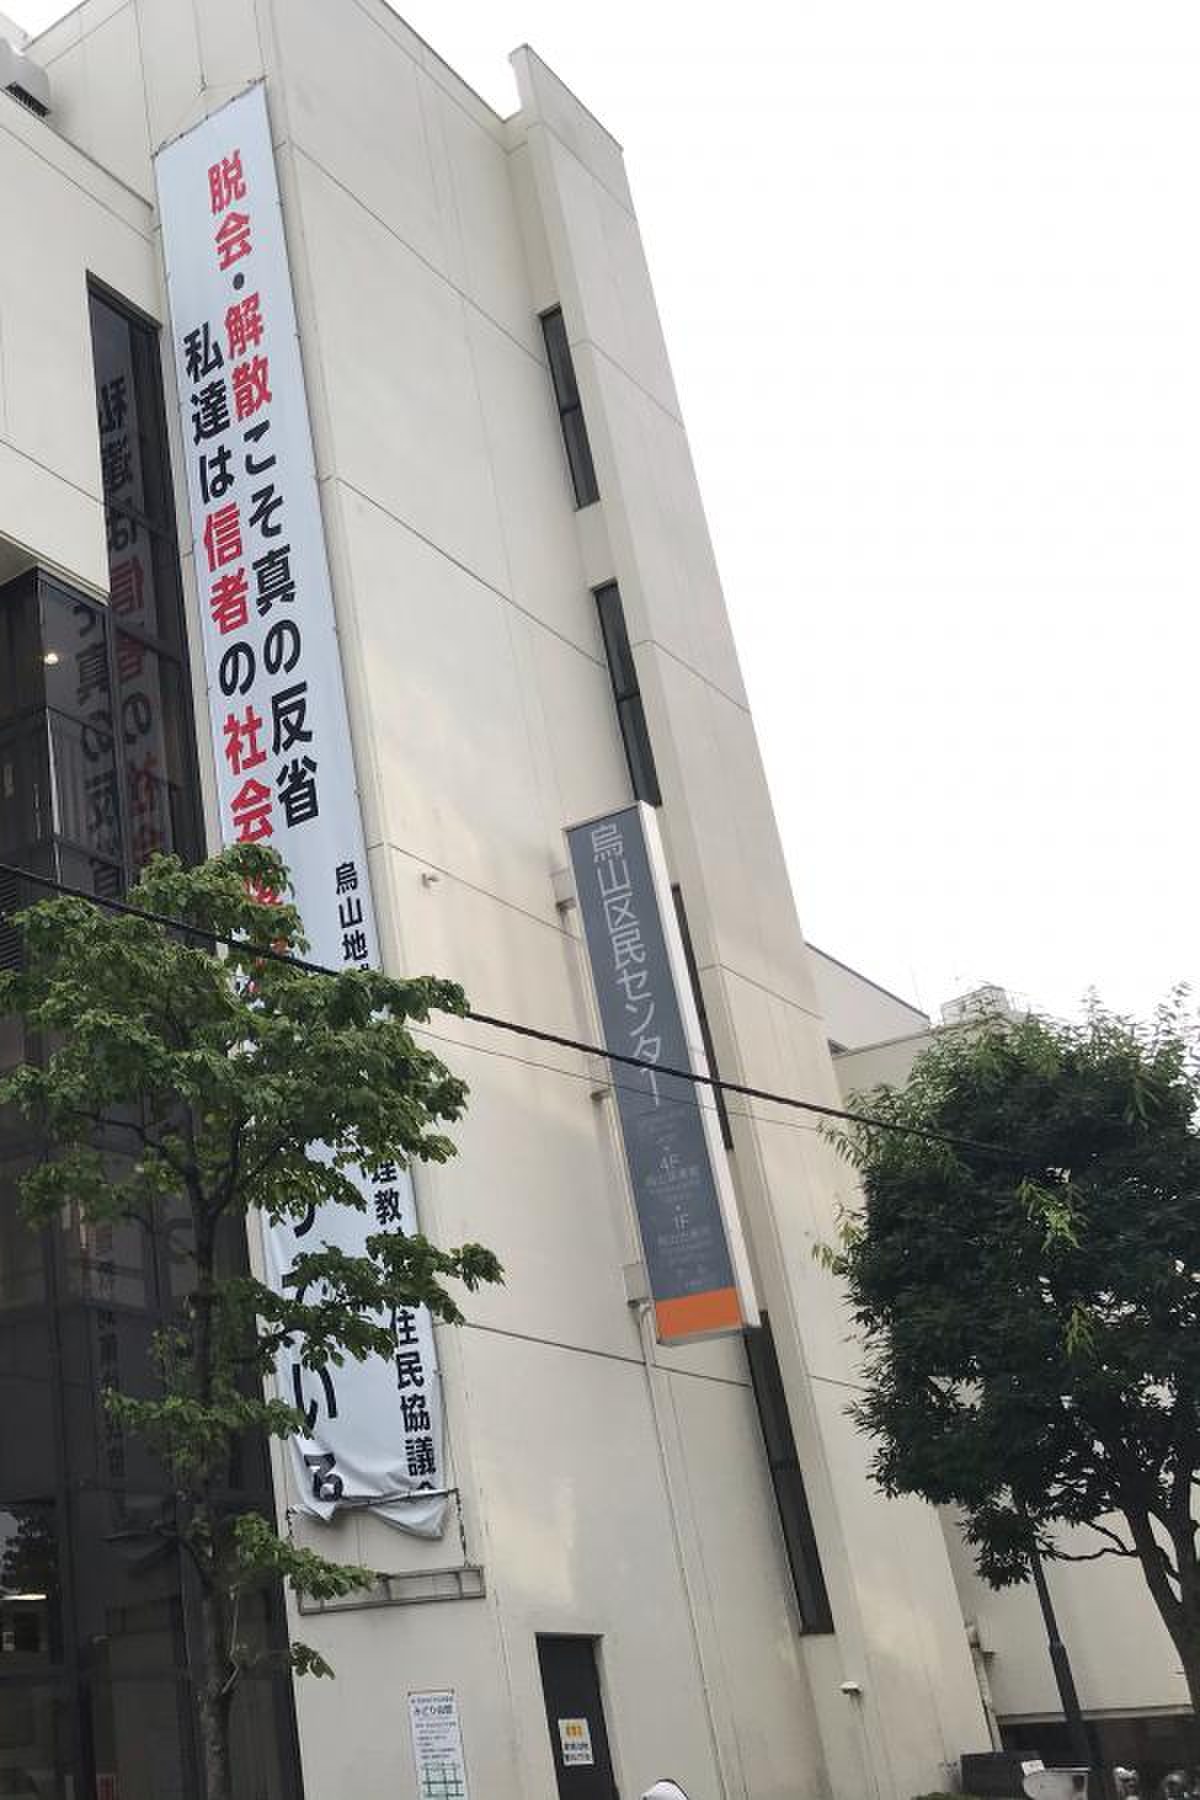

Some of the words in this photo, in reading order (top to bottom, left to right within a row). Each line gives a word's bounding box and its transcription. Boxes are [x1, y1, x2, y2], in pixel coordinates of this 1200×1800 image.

[207, 148, 320, 829] 脱会・解散こそ真の反省
[591, 822, 662, 1106] 烏山区民センター
